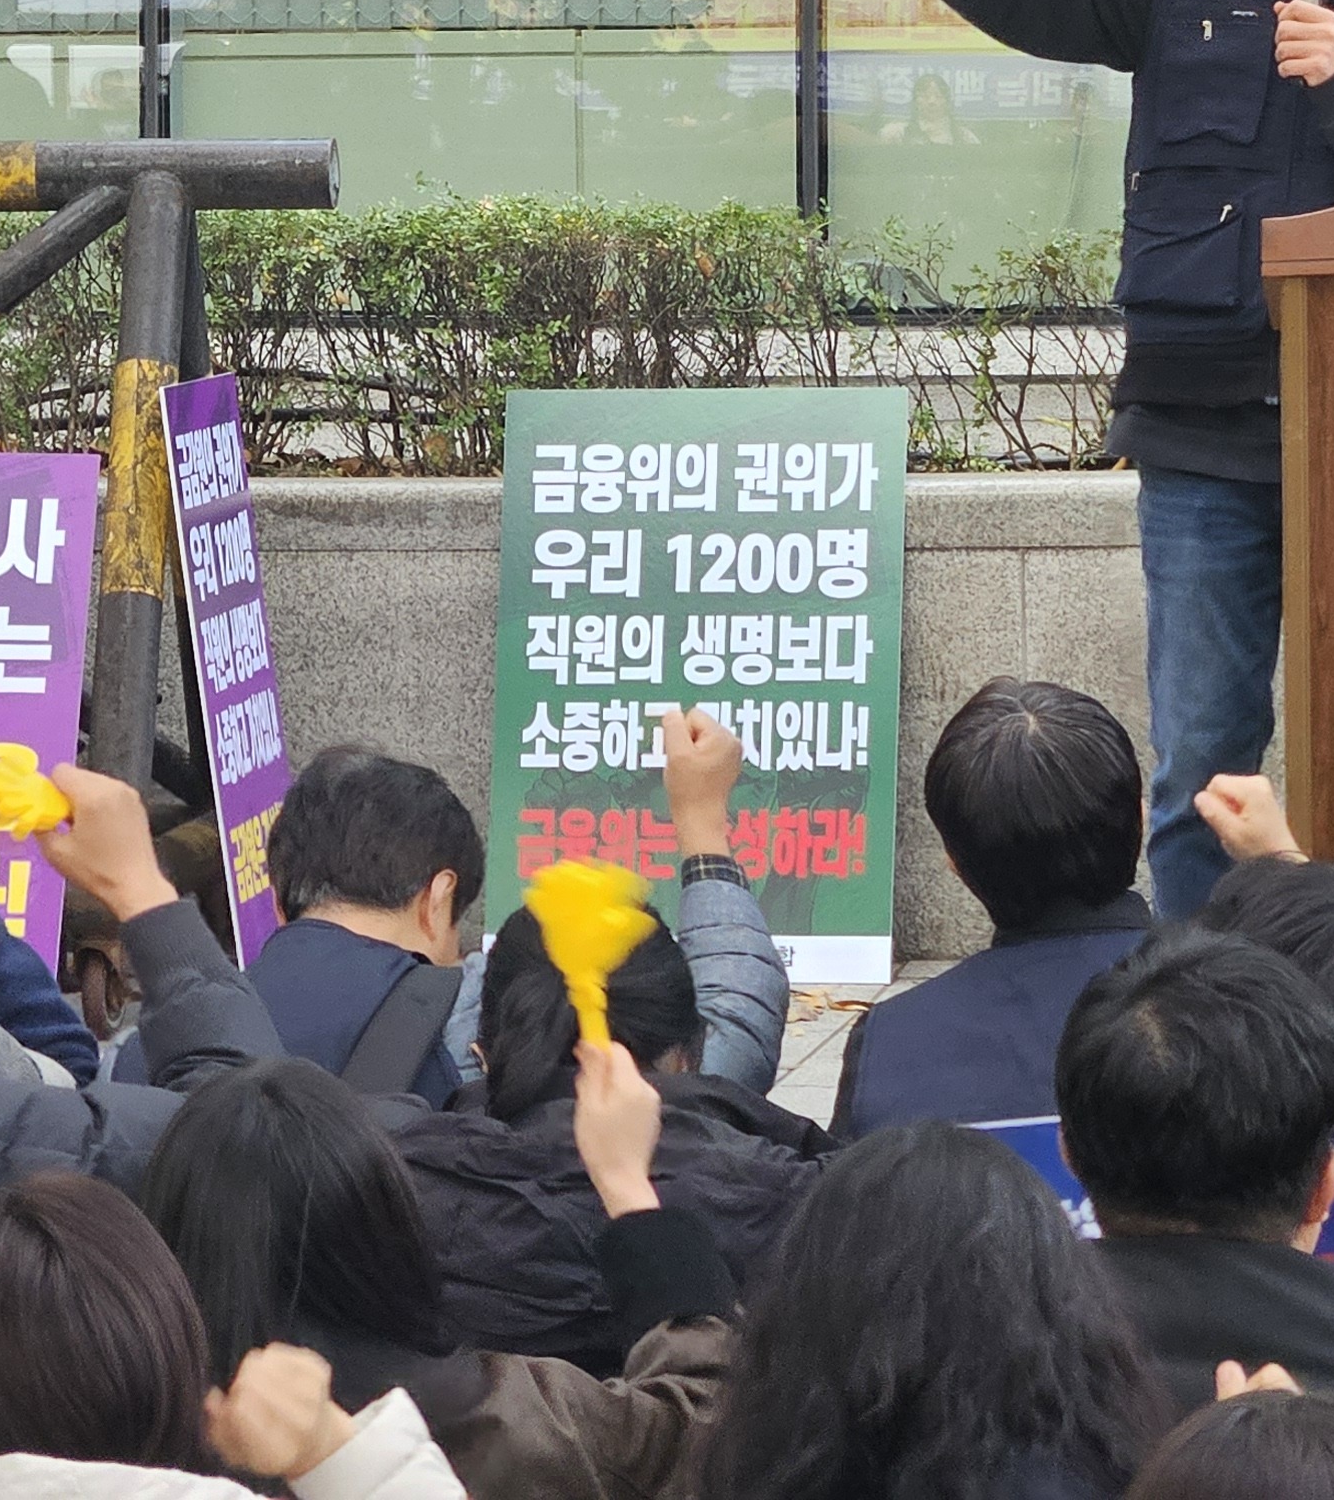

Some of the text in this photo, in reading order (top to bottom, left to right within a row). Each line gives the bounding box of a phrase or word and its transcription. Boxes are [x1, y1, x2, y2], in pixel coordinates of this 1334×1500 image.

[175, 420, 244, 509] 금감원의 권위가
[532, 442, 879, 513] 금융위의 권위가
[189, 509, 255, 601] 우리 1200명
[532, 528, 868, 599] 우리 1200명
[200, 598, 269, 693] 직원의 생명보다
[526, 615, 873, 685] 직원의 생명보다
[215, 703, 252, 785] 소중하고
[724, 807, 866, 880] 성하라!
